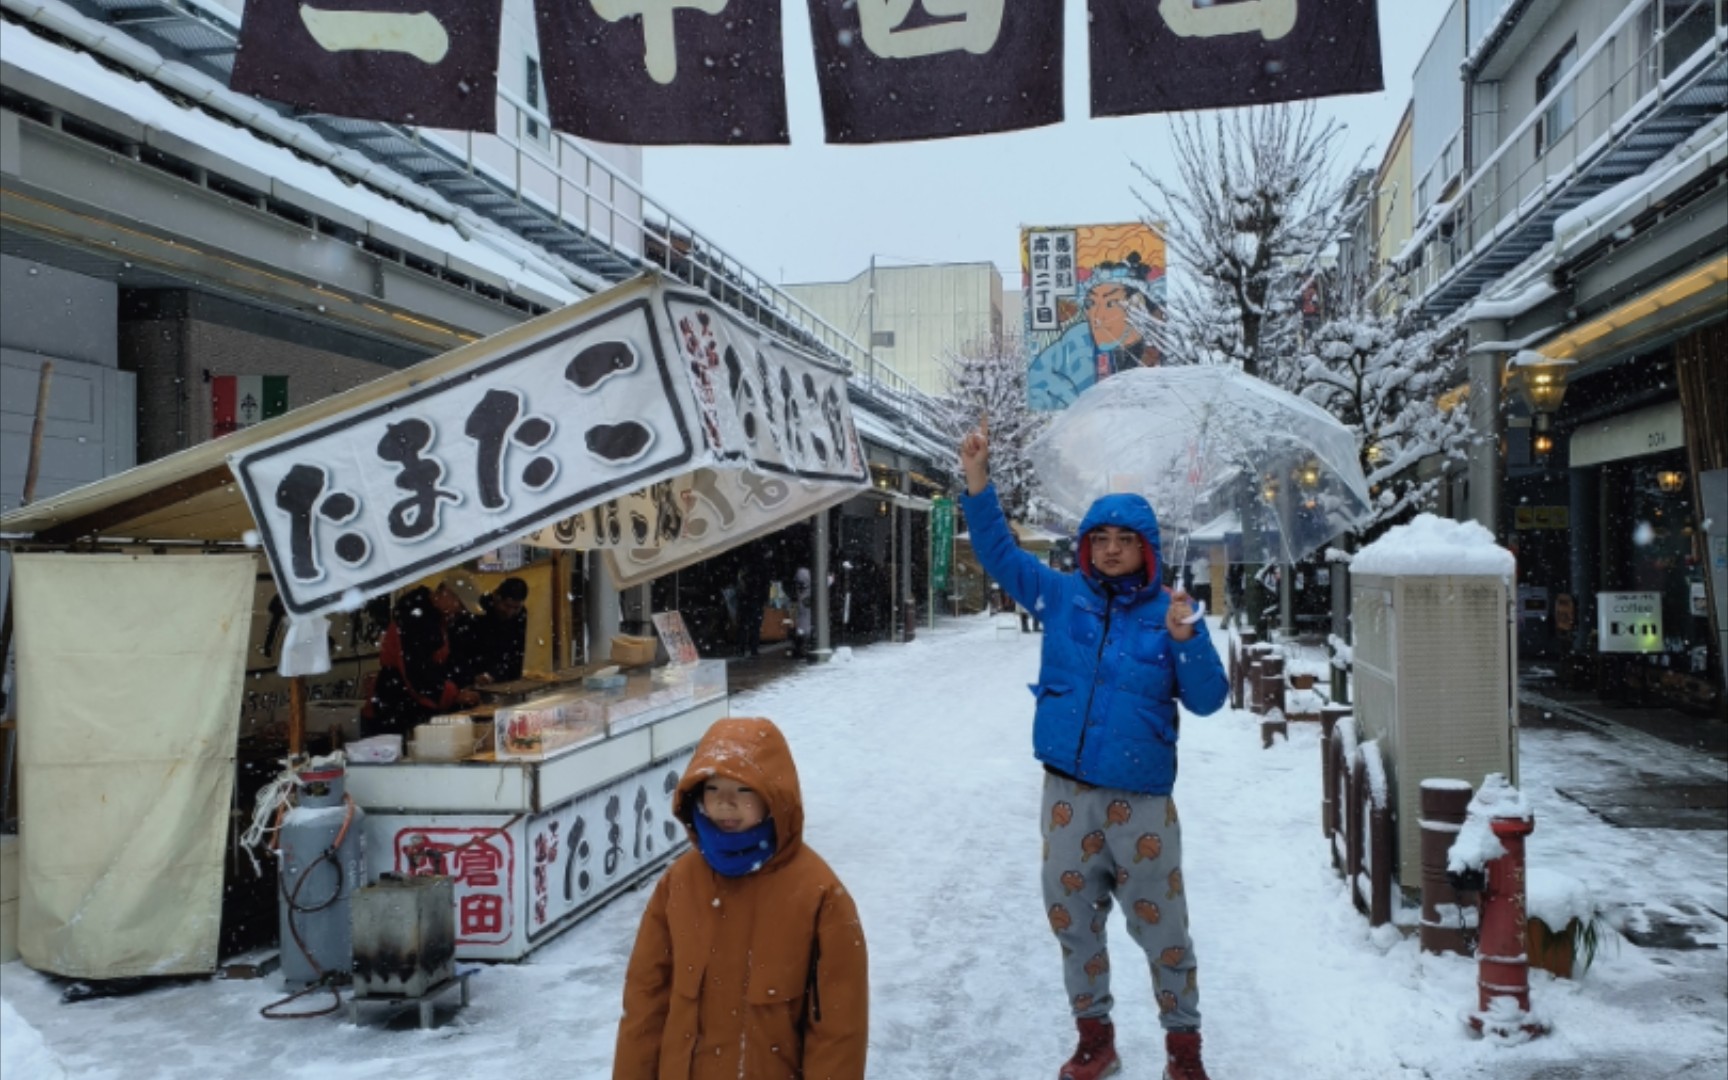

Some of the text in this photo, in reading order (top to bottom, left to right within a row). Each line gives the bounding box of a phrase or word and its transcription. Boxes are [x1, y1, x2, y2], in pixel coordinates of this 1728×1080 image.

[275, 340, 652, 579] たまたこ
[1613, 603, 1653, 613] coffee
[454, 835, 503, 935] 倉田
